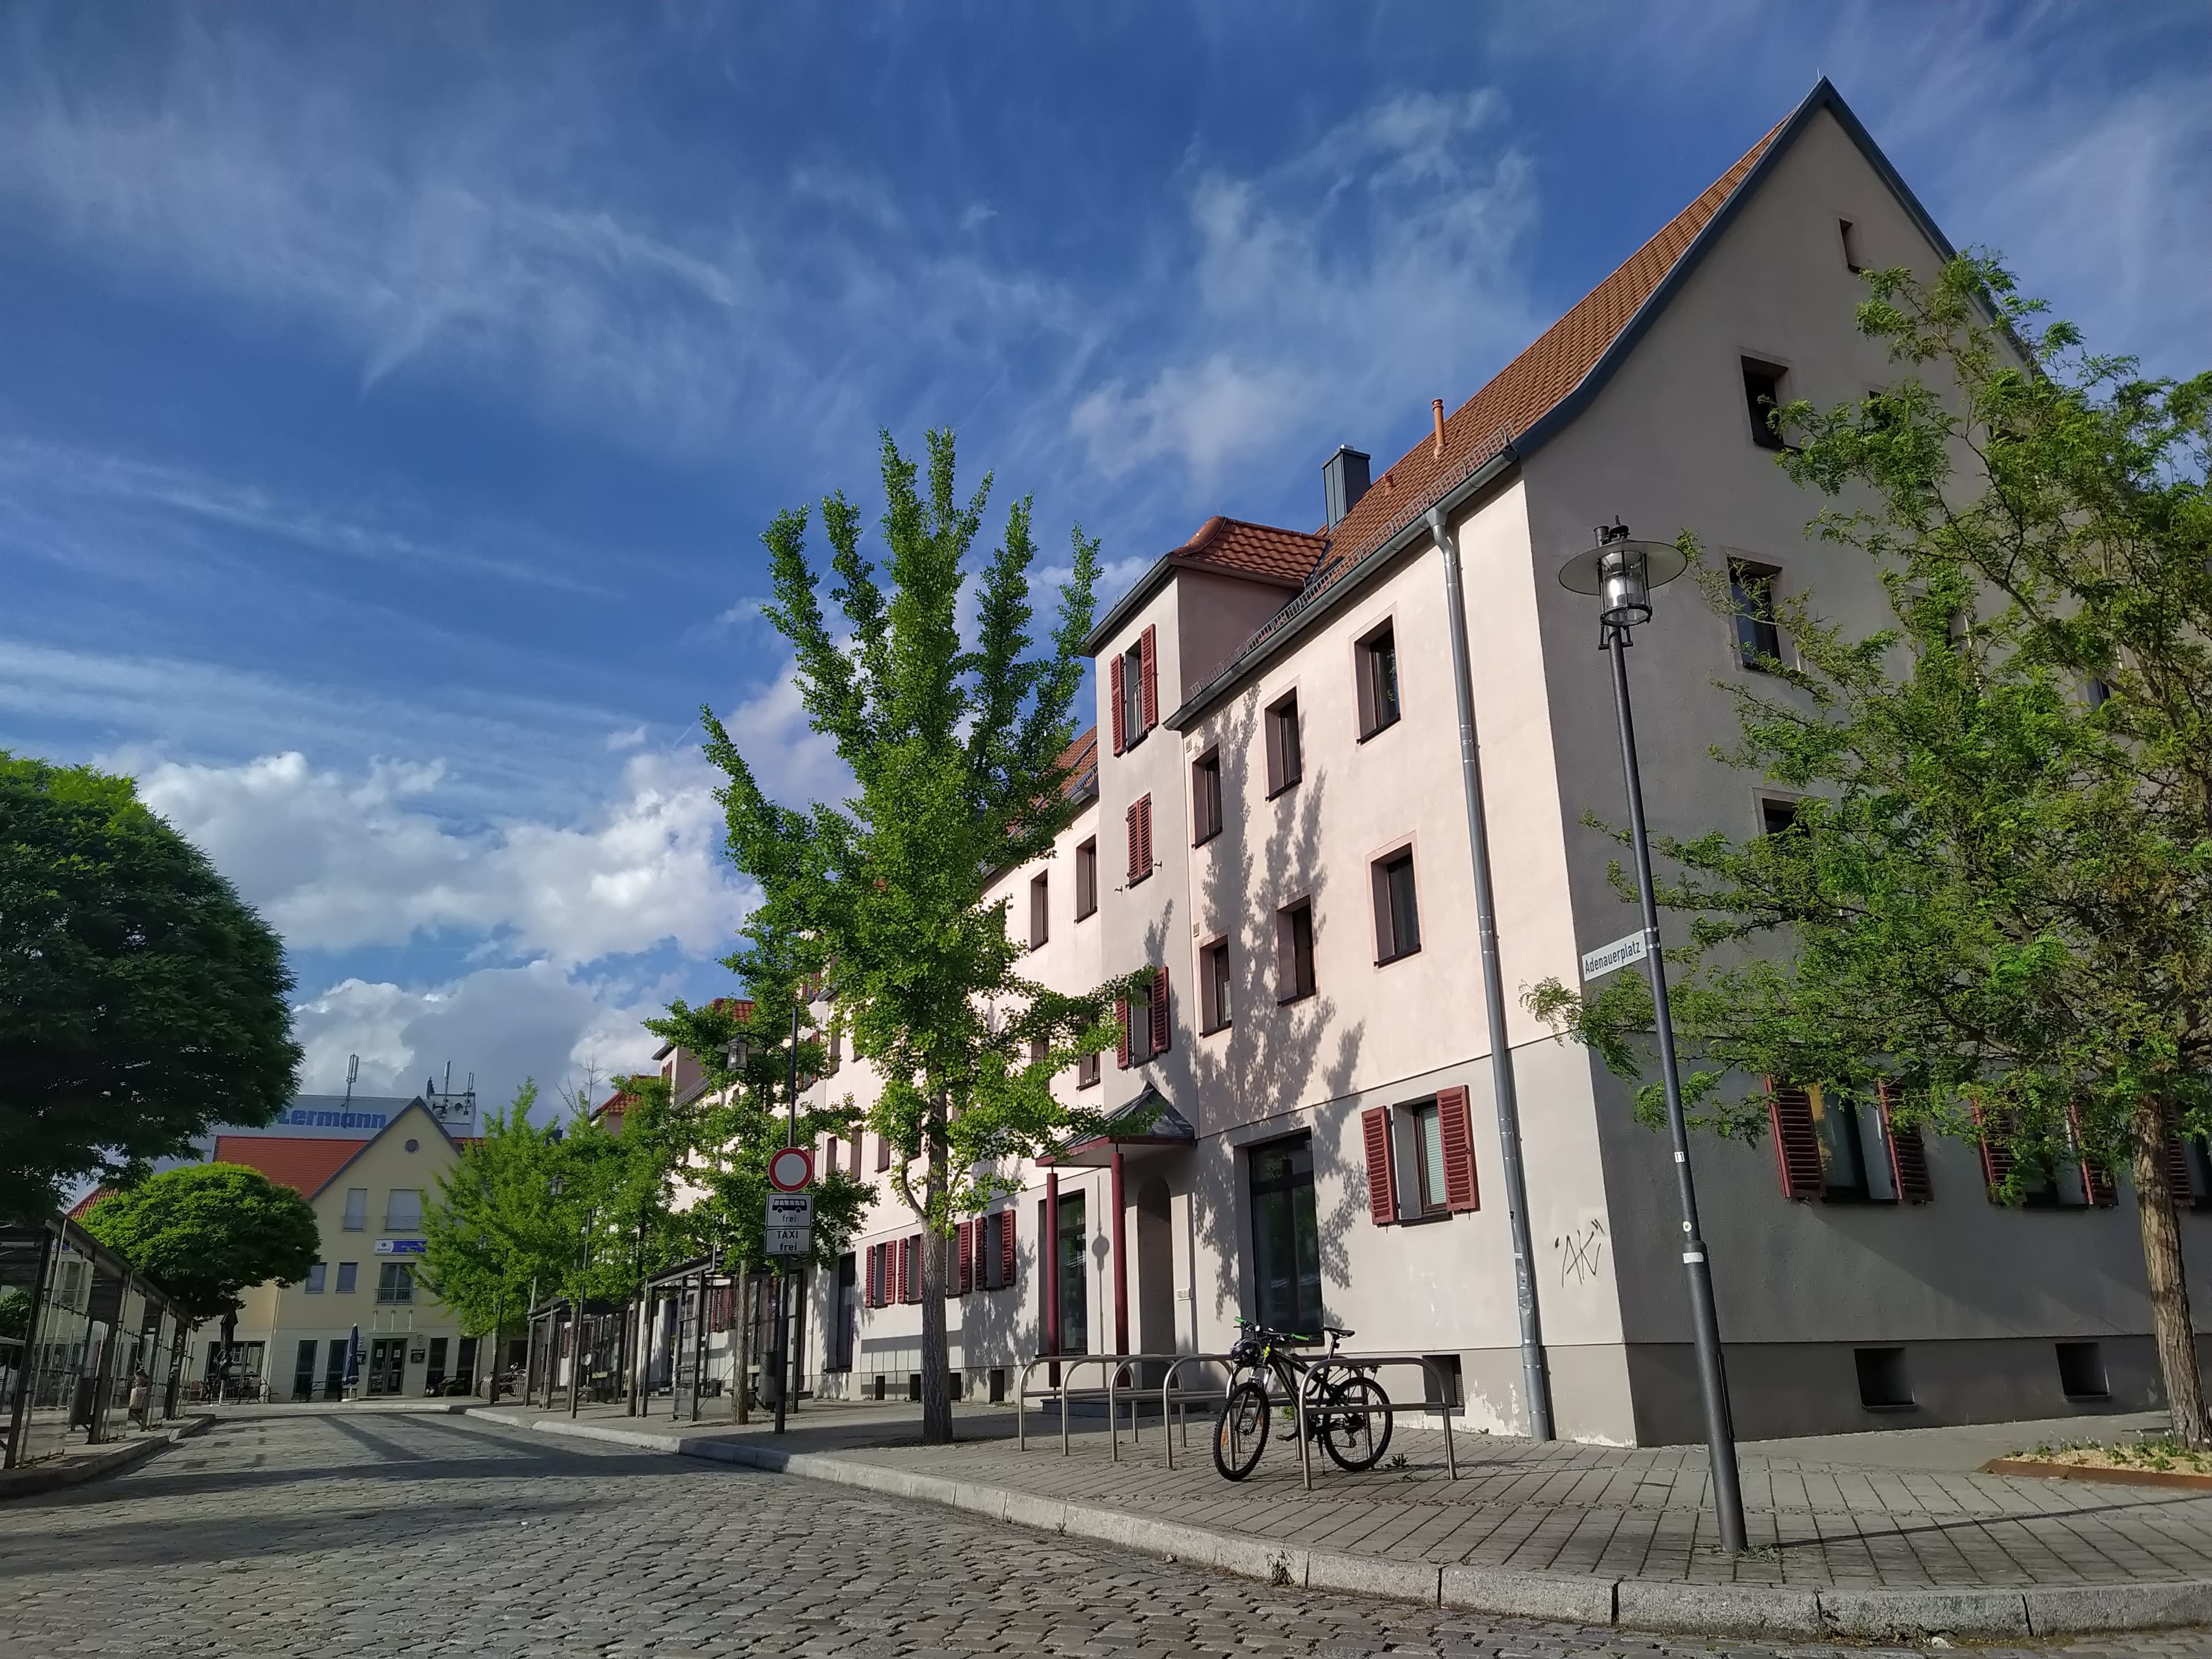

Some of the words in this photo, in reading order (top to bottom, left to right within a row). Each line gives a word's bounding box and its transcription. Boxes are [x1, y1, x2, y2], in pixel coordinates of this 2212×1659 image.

[1585, 940, 1641, 975] Adenauerplatz
[1675, 1153, 1684, 1161] 11
[782, 1214, 797, 1222] frei
[776, 1230, 799, 1239] TAXI
[780, 1242, 798, 1251] frei
